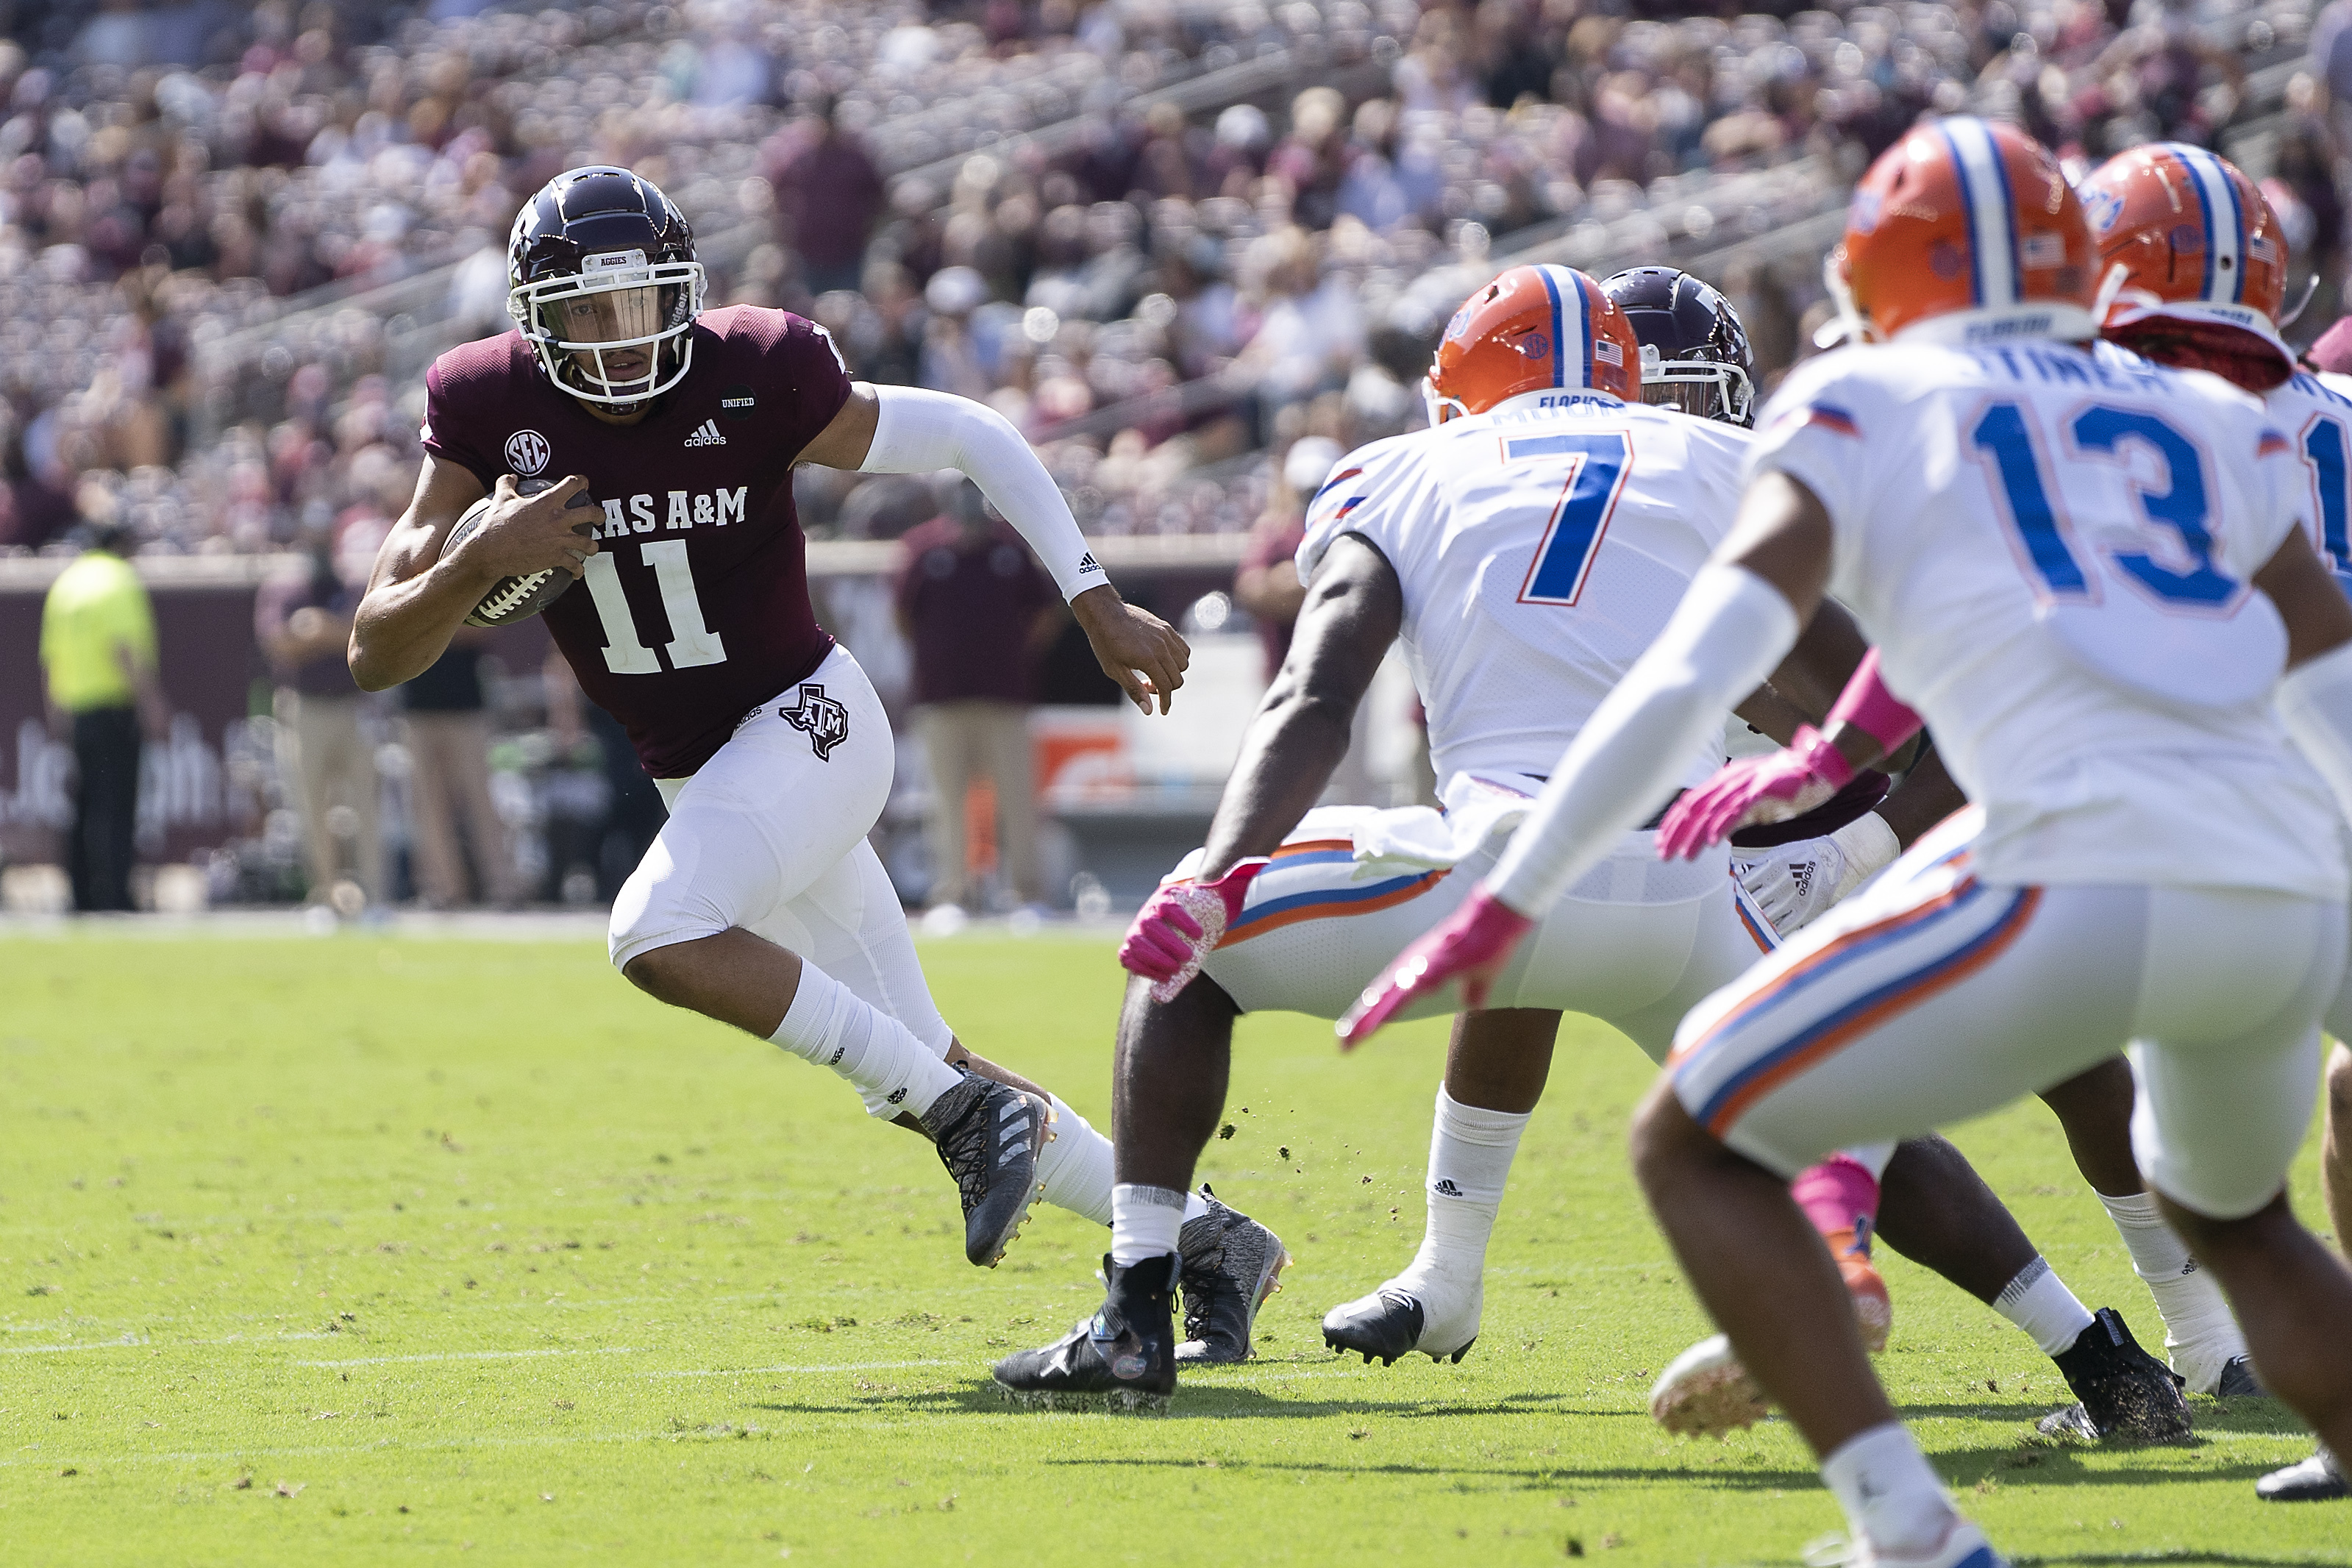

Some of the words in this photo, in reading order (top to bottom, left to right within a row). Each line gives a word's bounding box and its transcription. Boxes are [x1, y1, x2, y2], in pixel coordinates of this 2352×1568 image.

[601, 256, 627, 266] AGGIES
[721, 398, 755, 408] UNIFIED
[508, 433, 546, 473] SEC
[684, 435, 727, 447] adidas
[666, 486, 748, 529] A&M
[1498, 430, 1634, 607] 7
[1959, 393, 2252, 621] 13
[1079, 565, 1102, 574] adida
[582, 538, 727, 674] 11
[1799, 860, 1816, 897] adidas
[1434, 1184, 1463, 1197] adidas
